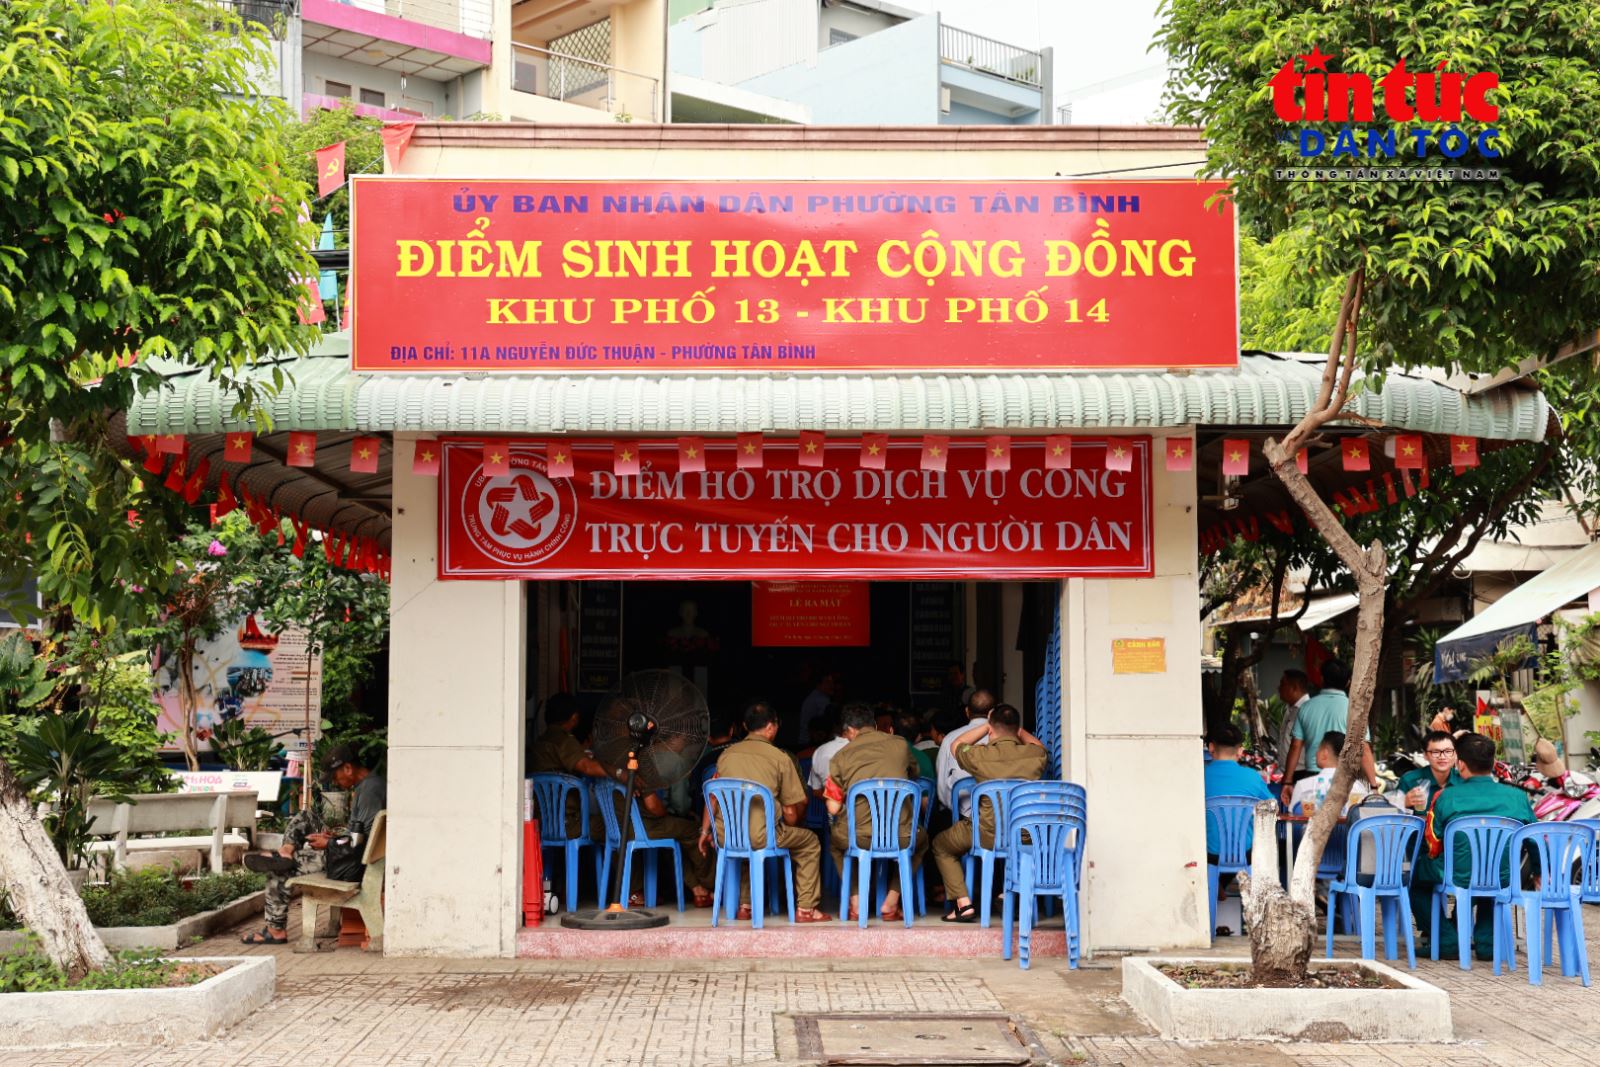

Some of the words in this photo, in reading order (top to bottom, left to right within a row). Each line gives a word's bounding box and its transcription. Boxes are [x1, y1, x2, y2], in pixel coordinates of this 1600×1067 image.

[452, 187, 499, 213] ỦY
[513, 195, 588, 213] BAN
[603, 192, 705, 213] NHÂN
[719, 192, 794, 213] DÂN
[807, 191, 957, 213] PHƯỜNG
[970, 192, 1040, 213] TÂN
[1053, 191, 1140, 213] BÌNH
[396, 217, 543, 278] ĐIỂM
[562, 239, 692, 279] SINH
[710, 239, 858, 286] HOẠT
[876, 228, 1025, 286] CỘNG
[1044, 217, 1196, 278] ĐỒNG
[486, 298, 594, 325] KHU
[610, 286, 716, 324] PHỐ
[734, 299, 780, 324] 13
[796, 309, 809, 318] -
[822, 297, 930, 324] KHU
[944, 285, 1050, 324] PHỐ
[1064, 298, 1110, 323] 14
[391, 346, 418, 363] ĐỊA
[424, 342, 455, 360] CHỈ:
[460, 346, 491, 361] 11A
[496, 341, 560, 361] NGUYỄN
[566, 342, 598, 360] ĐỨC
[603, 345, 655, 363] THUẬN
[671, 342, 737, 360] PHƯỜNG
[742, 342, 773, 360] TÂN
[777, 342, 816, 360] BÌNH
[589, 460, 687, 500] ĐIỂM
[765, 469, 842, 507] TRỢ
[853, 469, 948, 505] DỊCH
[957, 469, 1010, 505] VỤ
[585, 521, 684, 560] TRỰC
[695, 515, 815, 555] TUYẾN
[827, 520, 909, 553] CHO
[920, 514, 1043, 552] NGƯỜI
[1056, 516, 1132, 551] DÂN
